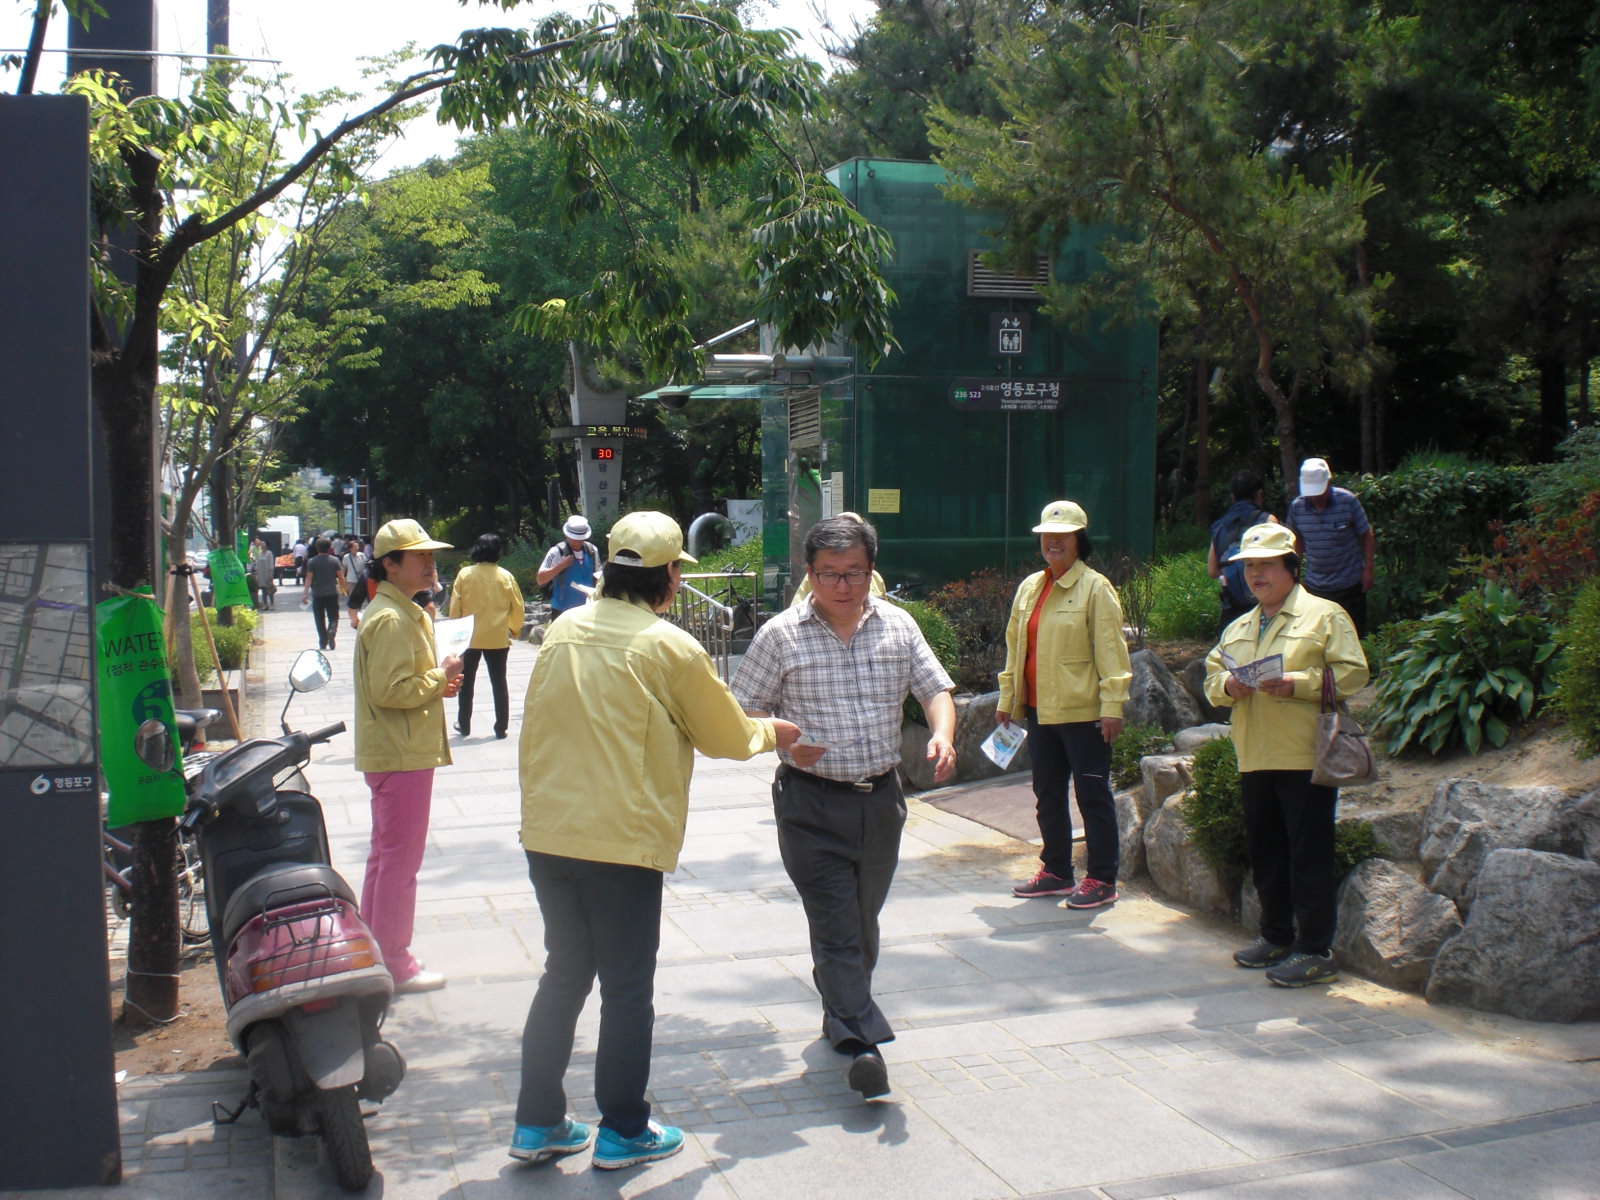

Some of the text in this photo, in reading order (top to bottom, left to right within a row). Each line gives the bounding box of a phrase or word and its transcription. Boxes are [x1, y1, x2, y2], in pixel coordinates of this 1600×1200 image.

[1000, 382, 1060, 398] 영등포구청
[598, 449, 612, 458] 30
[54, 776, 92, 789] 영등포구
